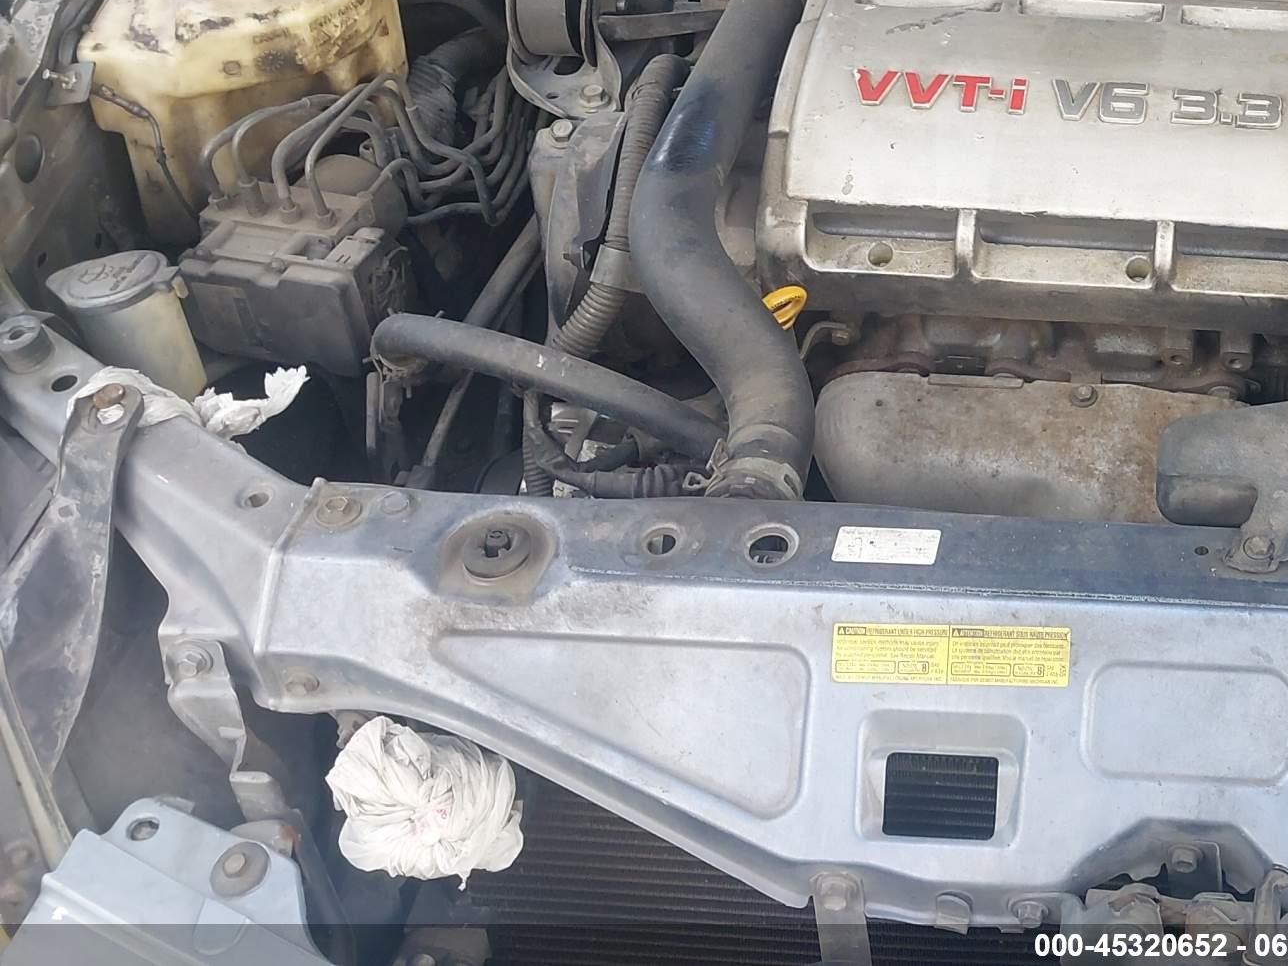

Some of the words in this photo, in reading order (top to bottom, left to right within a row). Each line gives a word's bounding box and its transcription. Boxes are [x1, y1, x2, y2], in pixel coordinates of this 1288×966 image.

[855, 67, 1030, 115] VVT-i
[1050, 77, 1151, 123] V6
[1169, 87, 1286, 129] 3.3
